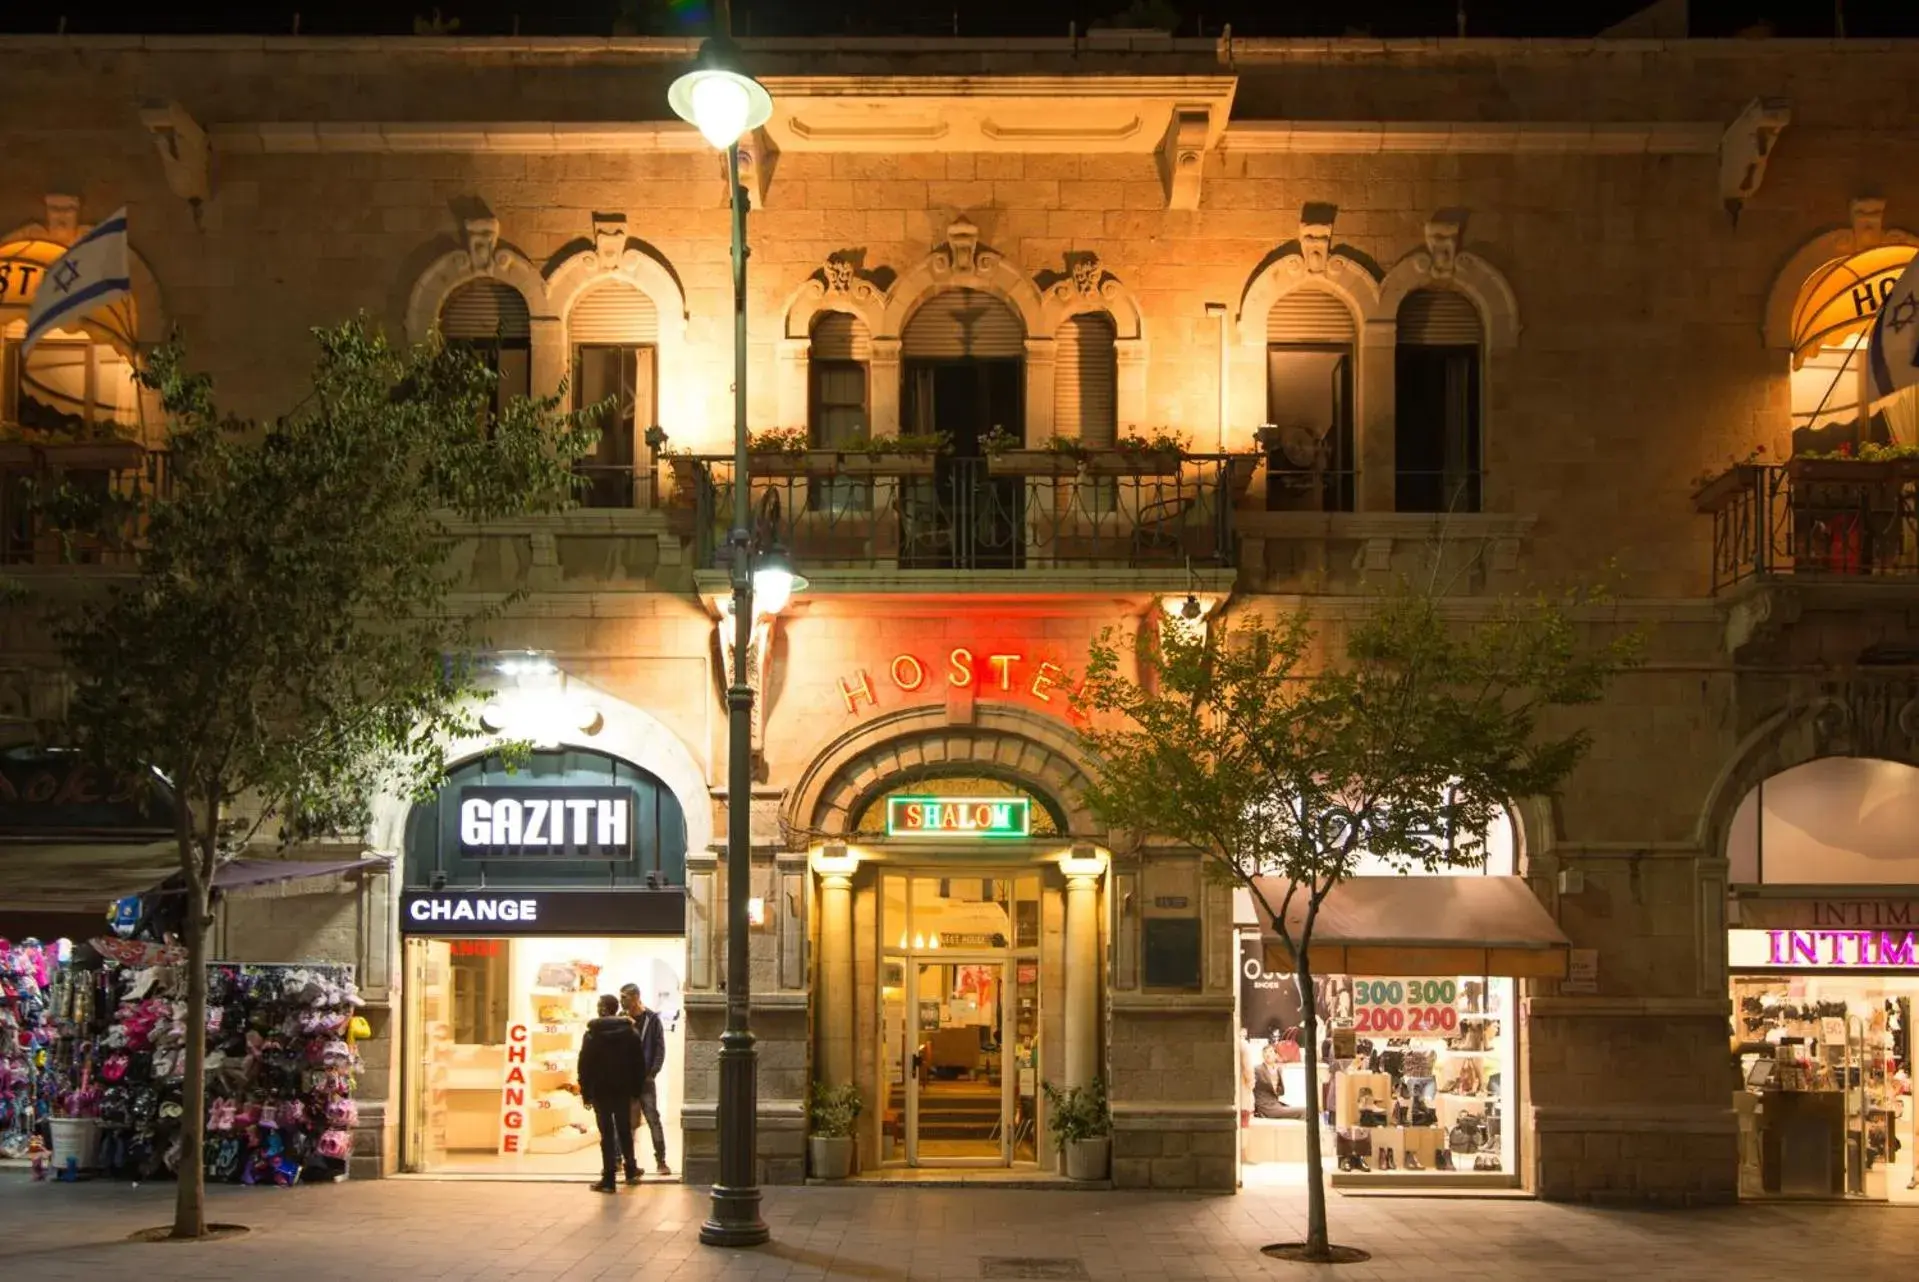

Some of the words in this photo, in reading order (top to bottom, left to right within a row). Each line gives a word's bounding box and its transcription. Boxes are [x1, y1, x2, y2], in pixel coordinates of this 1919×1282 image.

[461, 798, 627, 846] GAZITH
[907, 804, 1011, 829] SHALOM
[410, 900, 537, 921] CHANGE
[1766, 930, 1919, 965] INTIM
[1355, 981, 1403, 1005] 300
[1407, 980, 1456, 1004] 300
[1354, 1007, 1404, 1032] 200
[1408, 1007, 1457, 1031] 200
[504, 1024, 528, 1153] CHANGE
